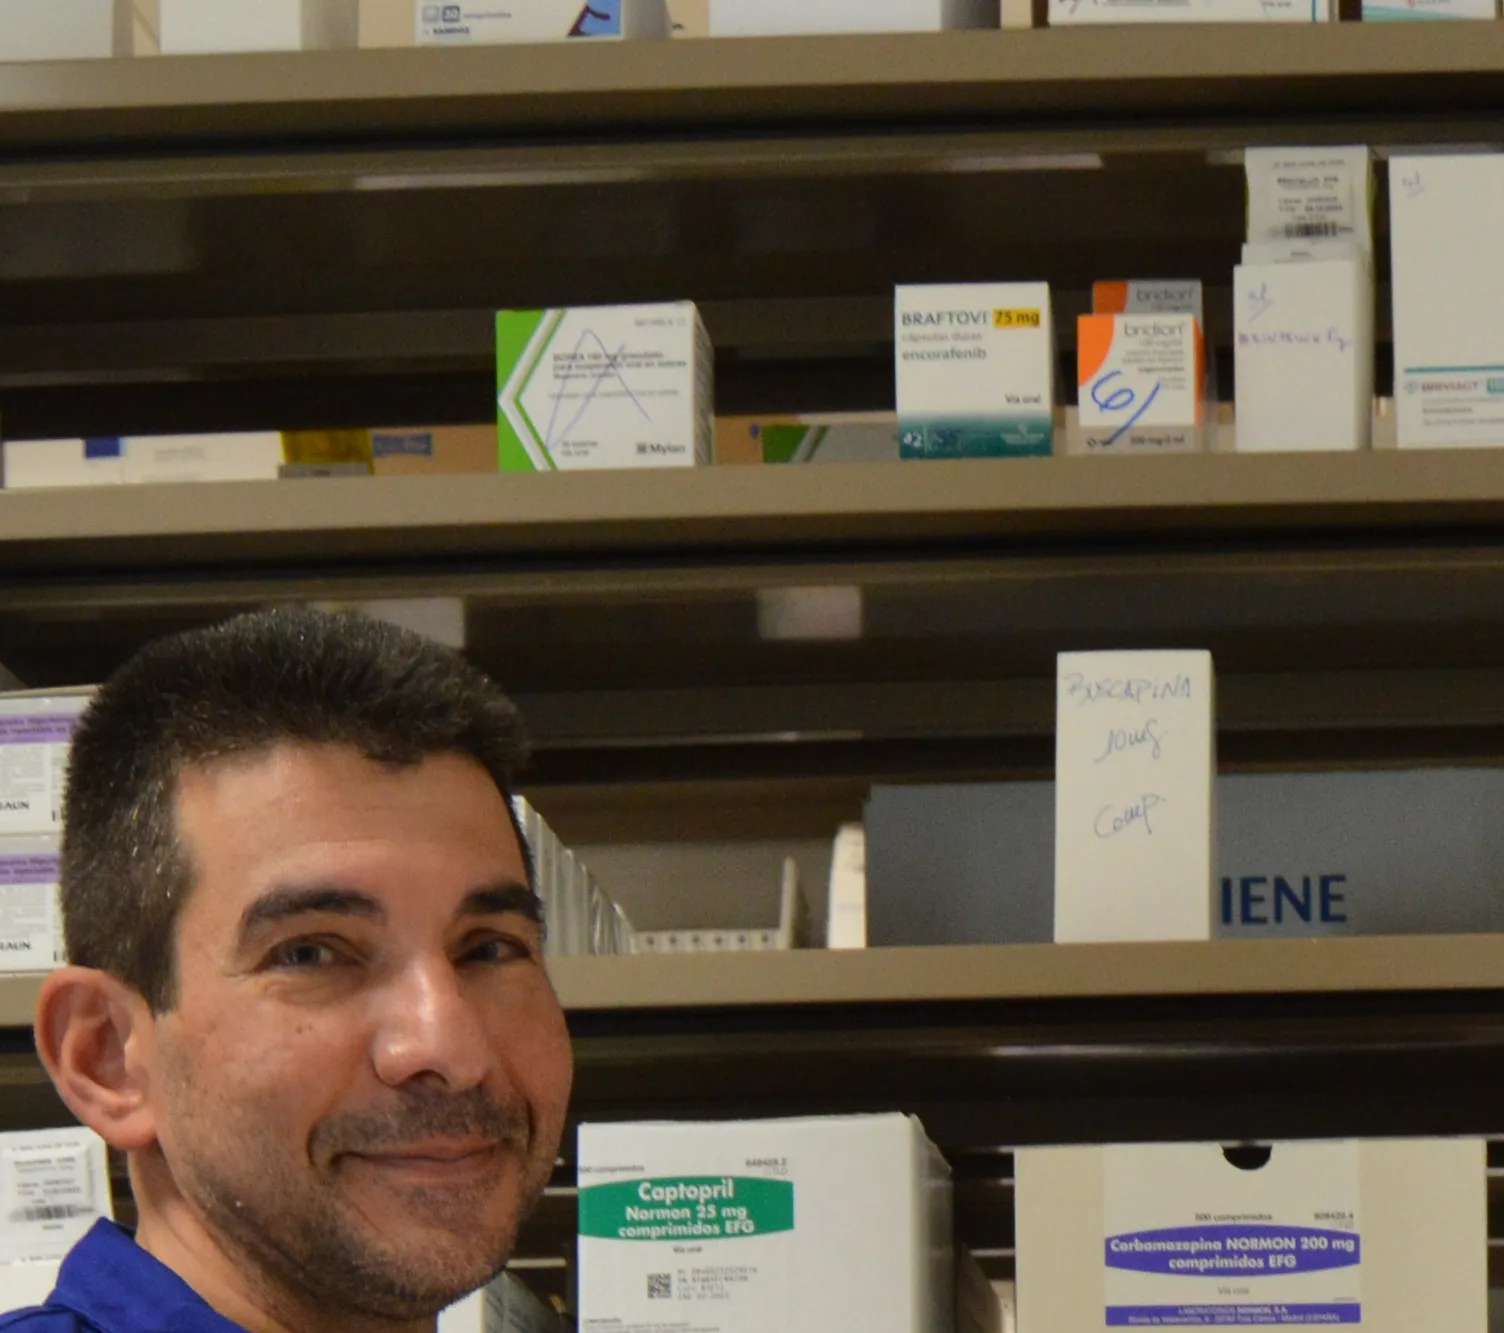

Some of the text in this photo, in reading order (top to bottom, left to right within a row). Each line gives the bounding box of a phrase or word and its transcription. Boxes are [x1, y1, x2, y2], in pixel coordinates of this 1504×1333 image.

[996, 310, 1012, 326] 75
[1015, 312, 1041, 328] mg
[638, 1178, 735, 1206] Captopril
[625, 1204, 748, 1222] Normon 25 mg
[618, 1219, 756, 1240] comprimidos EFG
[1110, 1236, 1355, 1255] Carbamazepina NORMON 200 mg
[1168, 1255, 1297, 1272] comprimidos EFG
